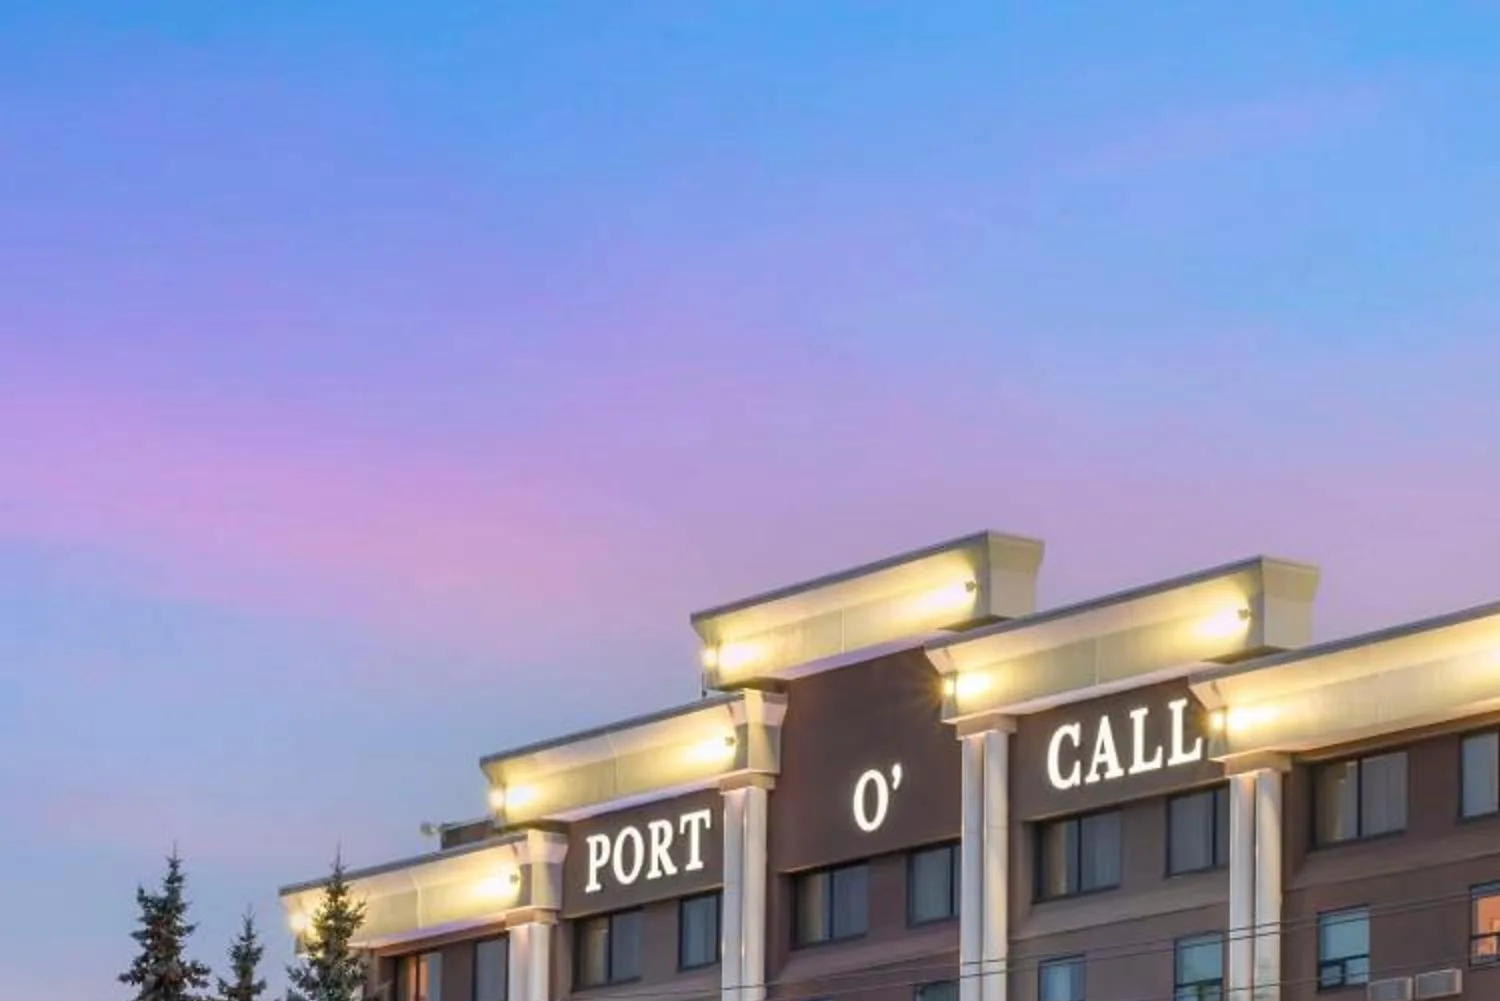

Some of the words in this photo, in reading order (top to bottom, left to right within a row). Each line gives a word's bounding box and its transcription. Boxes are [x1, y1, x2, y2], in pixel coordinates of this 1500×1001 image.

[585, 808, 711, 893] PORT
[853, 763, 903, 833] O'
[1047, 698, 1202, 790] CALL
